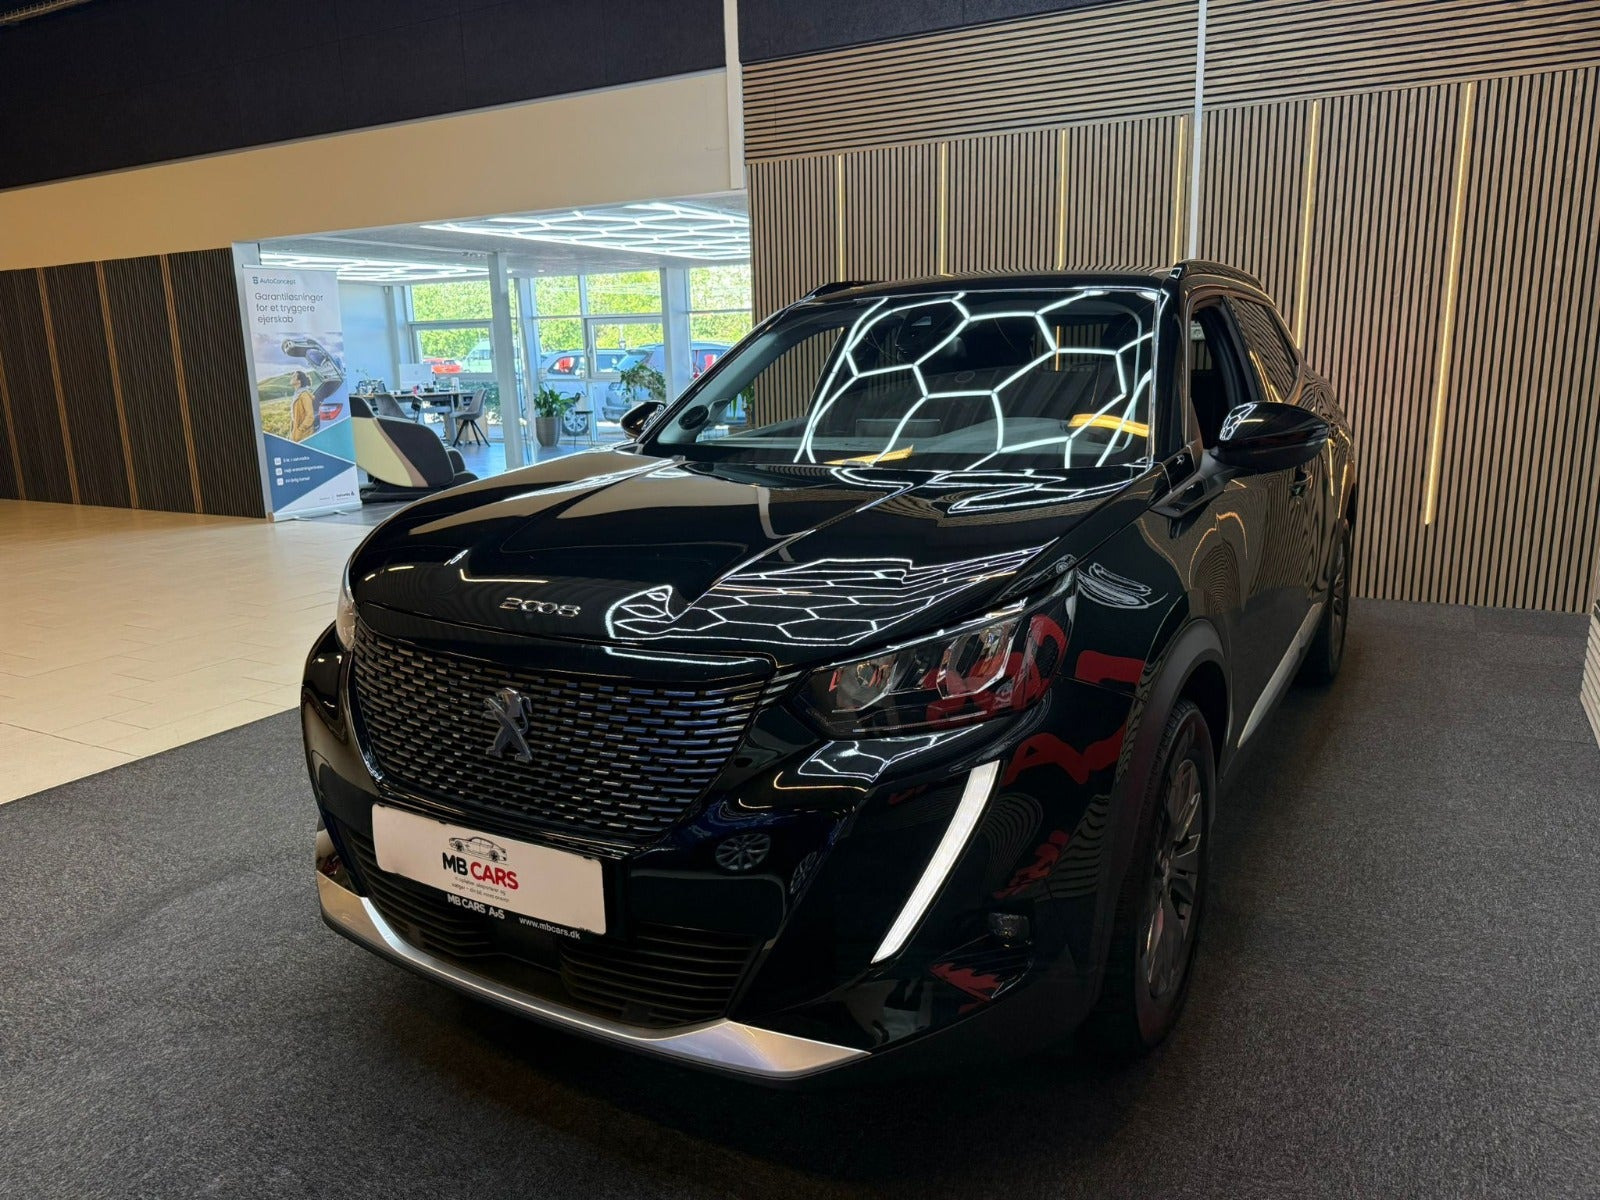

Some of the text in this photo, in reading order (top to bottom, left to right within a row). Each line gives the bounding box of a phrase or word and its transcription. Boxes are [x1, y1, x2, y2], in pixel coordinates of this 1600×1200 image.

[256, 303, 316, 314] for et tryggere
[258, 315, 294, 325] ejerskab
[500, 597, 580, 617] 2008
[442, 852, 468, 876] MB
[470, 861, 519, 890] CARS
[447, 893, 461, 906] MB
[462, 898, 486, 914] CARS
[518, 916, 581, 940] www.mbcars.dk
